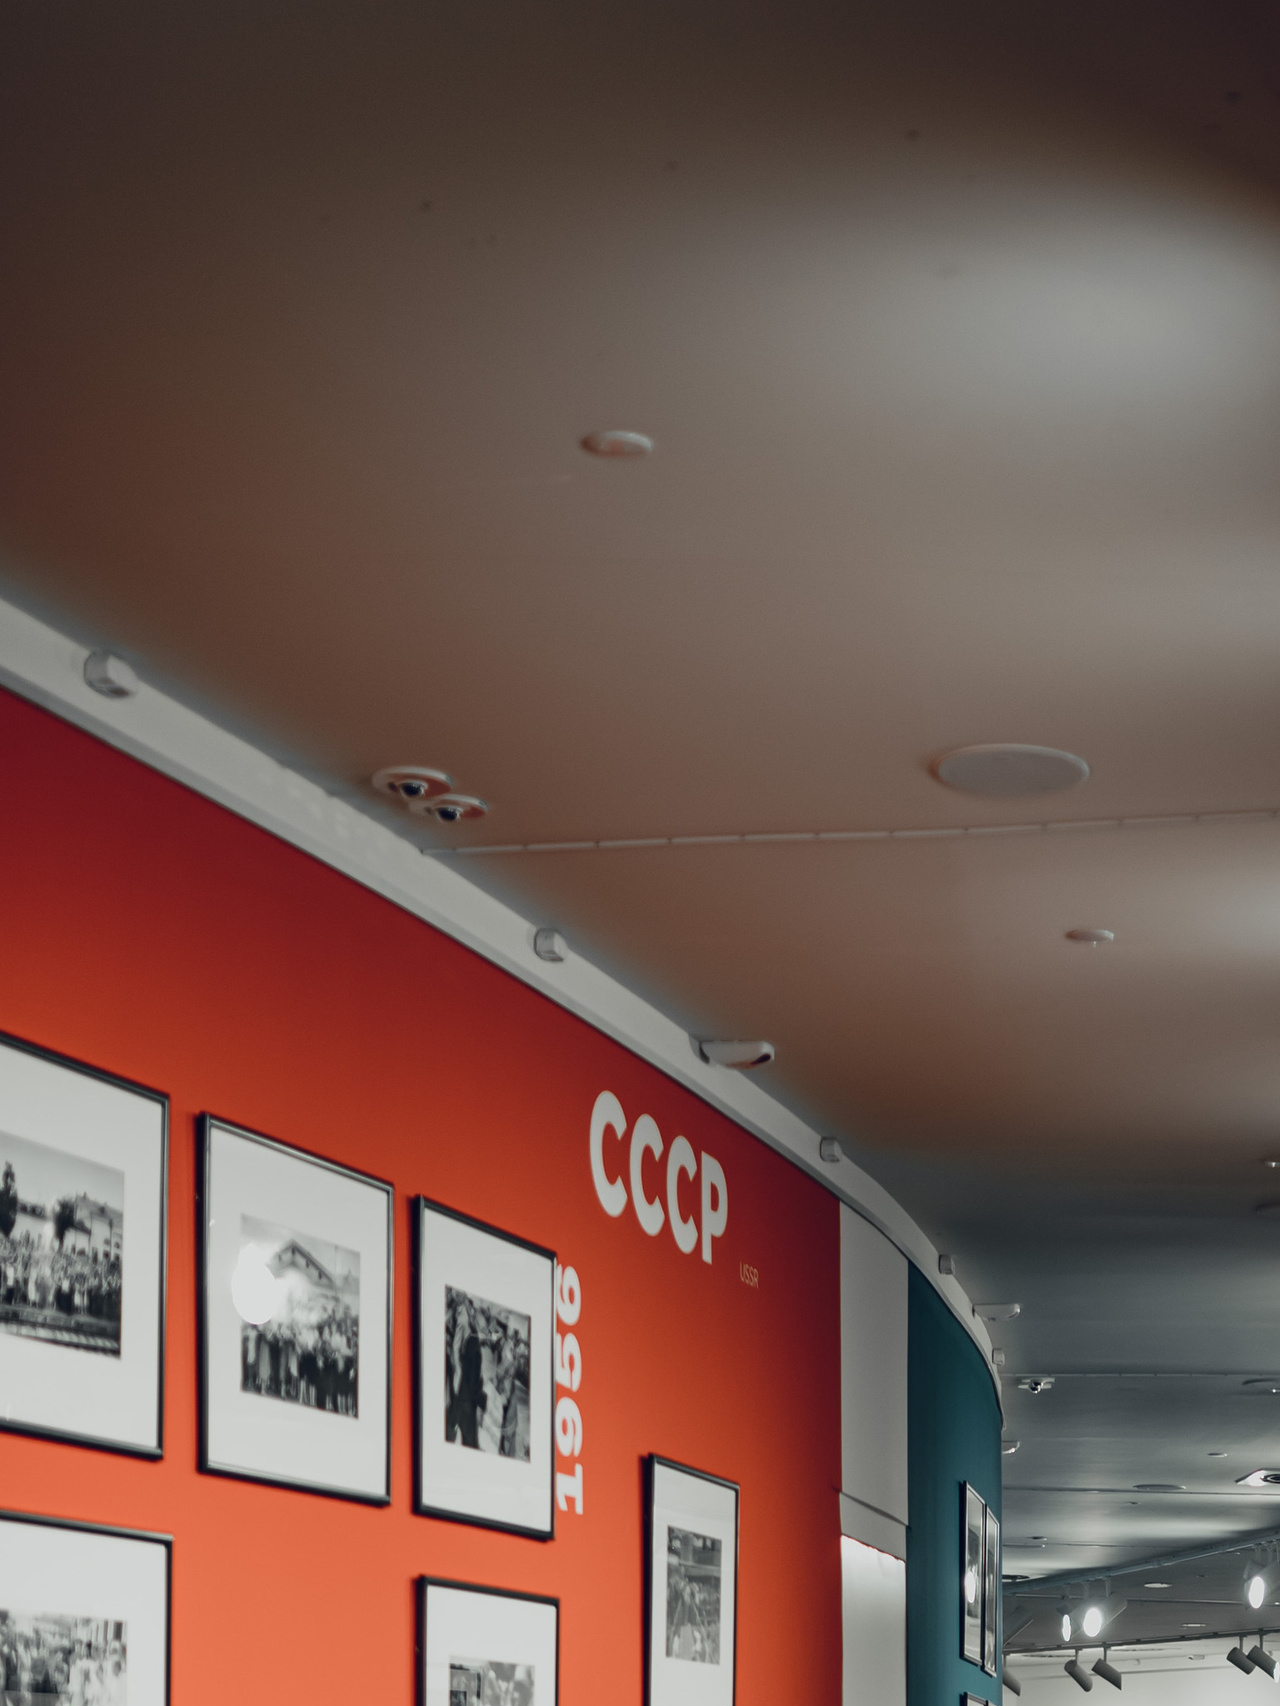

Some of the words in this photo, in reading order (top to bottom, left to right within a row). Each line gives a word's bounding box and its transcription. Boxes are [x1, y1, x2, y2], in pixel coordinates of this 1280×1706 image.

[589, 1090, 728, 1264] СССР
[740, 1261, 760, 1289] USSR
[556, 1265, 583, 1515] 1956
